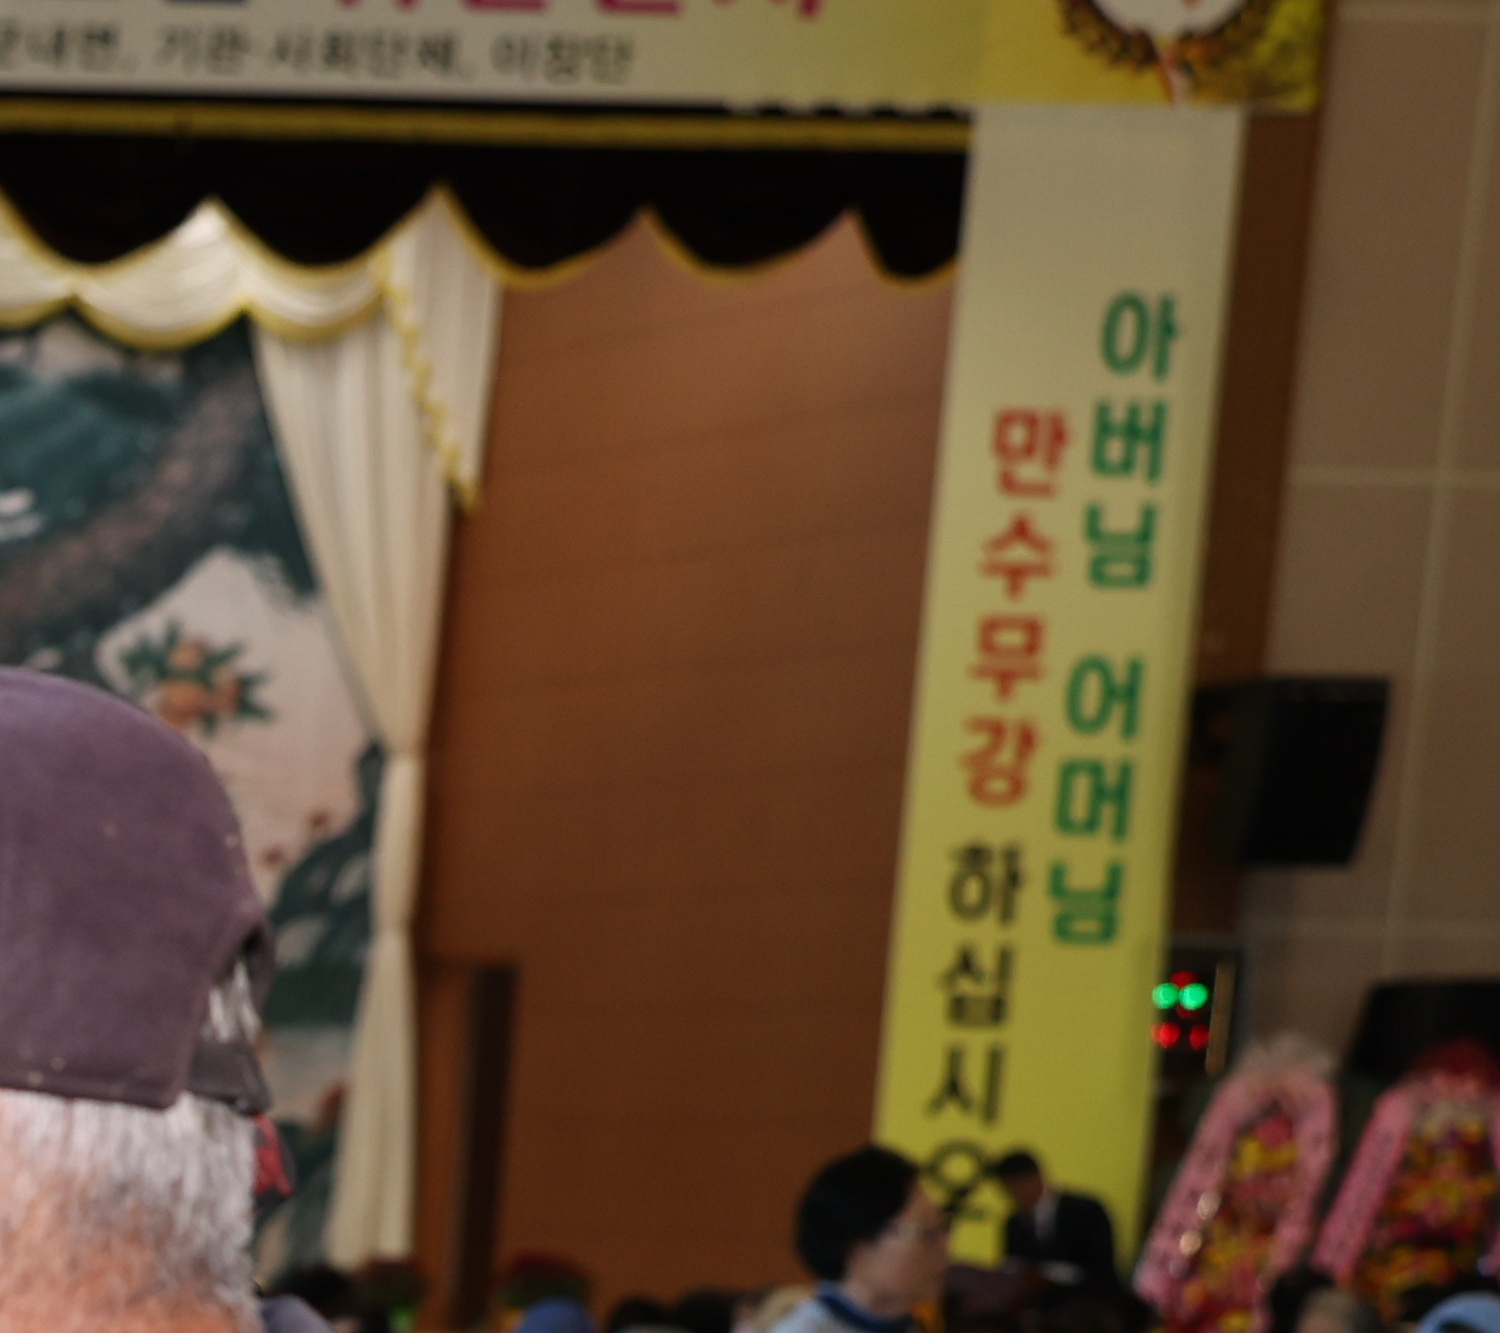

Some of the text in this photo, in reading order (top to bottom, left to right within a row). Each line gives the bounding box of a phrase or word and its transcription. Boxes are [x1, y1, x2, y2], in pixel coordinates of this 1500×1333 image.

[961, 407, 1071, 810] 만수무강
[1049, 291, 1180, 948] 아버님 어머님
